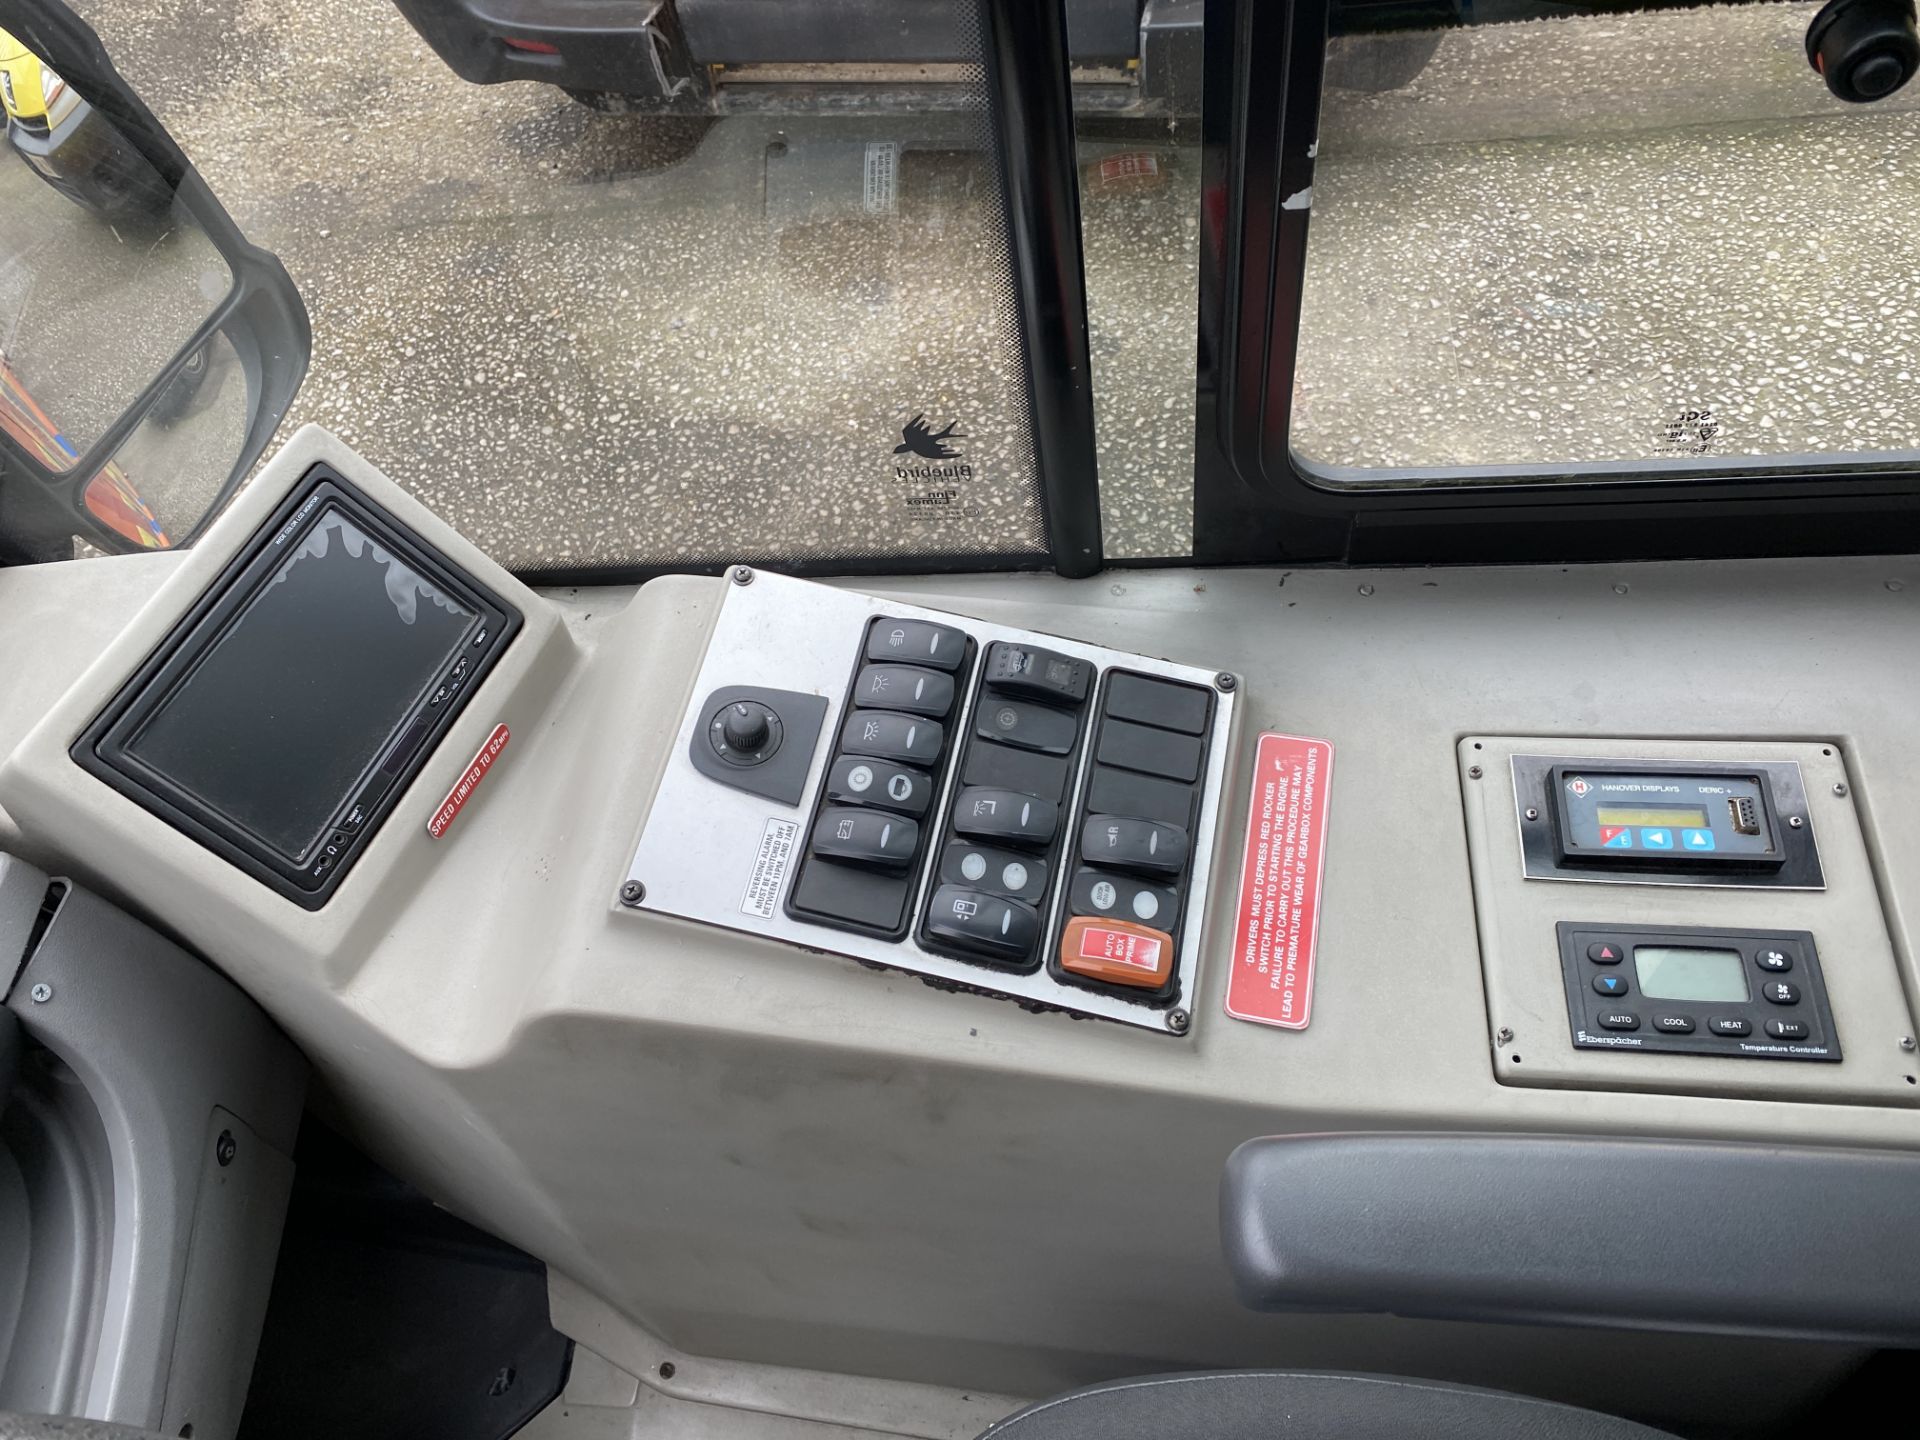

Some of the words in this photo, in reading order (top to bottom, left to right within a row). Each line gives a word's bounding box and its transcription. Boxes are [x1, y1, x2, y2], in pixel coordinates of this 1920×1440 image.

[1292, 765, 1303, 787] MAY
[1302, 747, 1318, 812] COMPONENTS
[1602, 784, 1641, 792] HANOVER
[1642, 784, 1680, 793] DISPLAYS
[432, 804, 454, 835] SPEED
[454, 766, 481, 805] LIMITED
[480, 753, 490, 767] TO
[1263, 782, 1275, 819] ROCKER
[1698, 786, 1724, 794] DERIC
[1274, 812, 1285, 832] THE
[1286, 787, 1300, 844] PROCEDURE
[1260, 820, 1271, 840] RED
[1298, 813, 1311, 860] GEARBOX
[1606, 830, 1612, 838] F
[1620, 836, 1626, 845] E
[755, 888, 766, 909] MUST
[762, 876, 770, 887] BE
[766, 840, 782, 876] SWITCHED
[776, 826, 786, 839] OFF
[1255, 842, 1268, 885] DEPRESS
[1268, 834, 1282, 882] STARTING
[1284, 846, 1295, 868] THIS
[1296, 860, 1306, 874] OF
[749, 860, 766, 898] REVERSING
[762, 881, 778, 916] BETWEEN
[780, 843, 790, 860] AND
[1266, 884, 1277, 897] TO
[1281, 870, 1292, 891] OUT
[1294, 876, 1306, 906] WEAR
[1251, 886, 1262, 916] MUST
[1277, 892, 1290, 928] CARRY
[1264, 900, 1275, 930] PRIOR
[1104, 934, 1116, 956] AUTO
[1116, 938, 1126, 956] BOX
[1125, 936, 1137, 963] PRIME
[1246, 919, 1259, 964] DRIVERS
[1275, 930, 1286, 943] TO
[1286, 908, 1302, 972] PREMATURE
[1258, 932, 1272, 974] SWITCH
[1270, 945, 1284, 990] FAILURE
[1284, 973, 1296, 988] TO
[1282, 990, 1294, 1019] LEAD
[1610, 1016, 1632, 1024] AUTO
[1664, 1018, 1688, 1026] COOL
[1720, 1020, 1743, 1030] HEAT
[1740, 1043, 1788, 1052] Temperature
[1789, 1046, 1828, 1054] Controller
